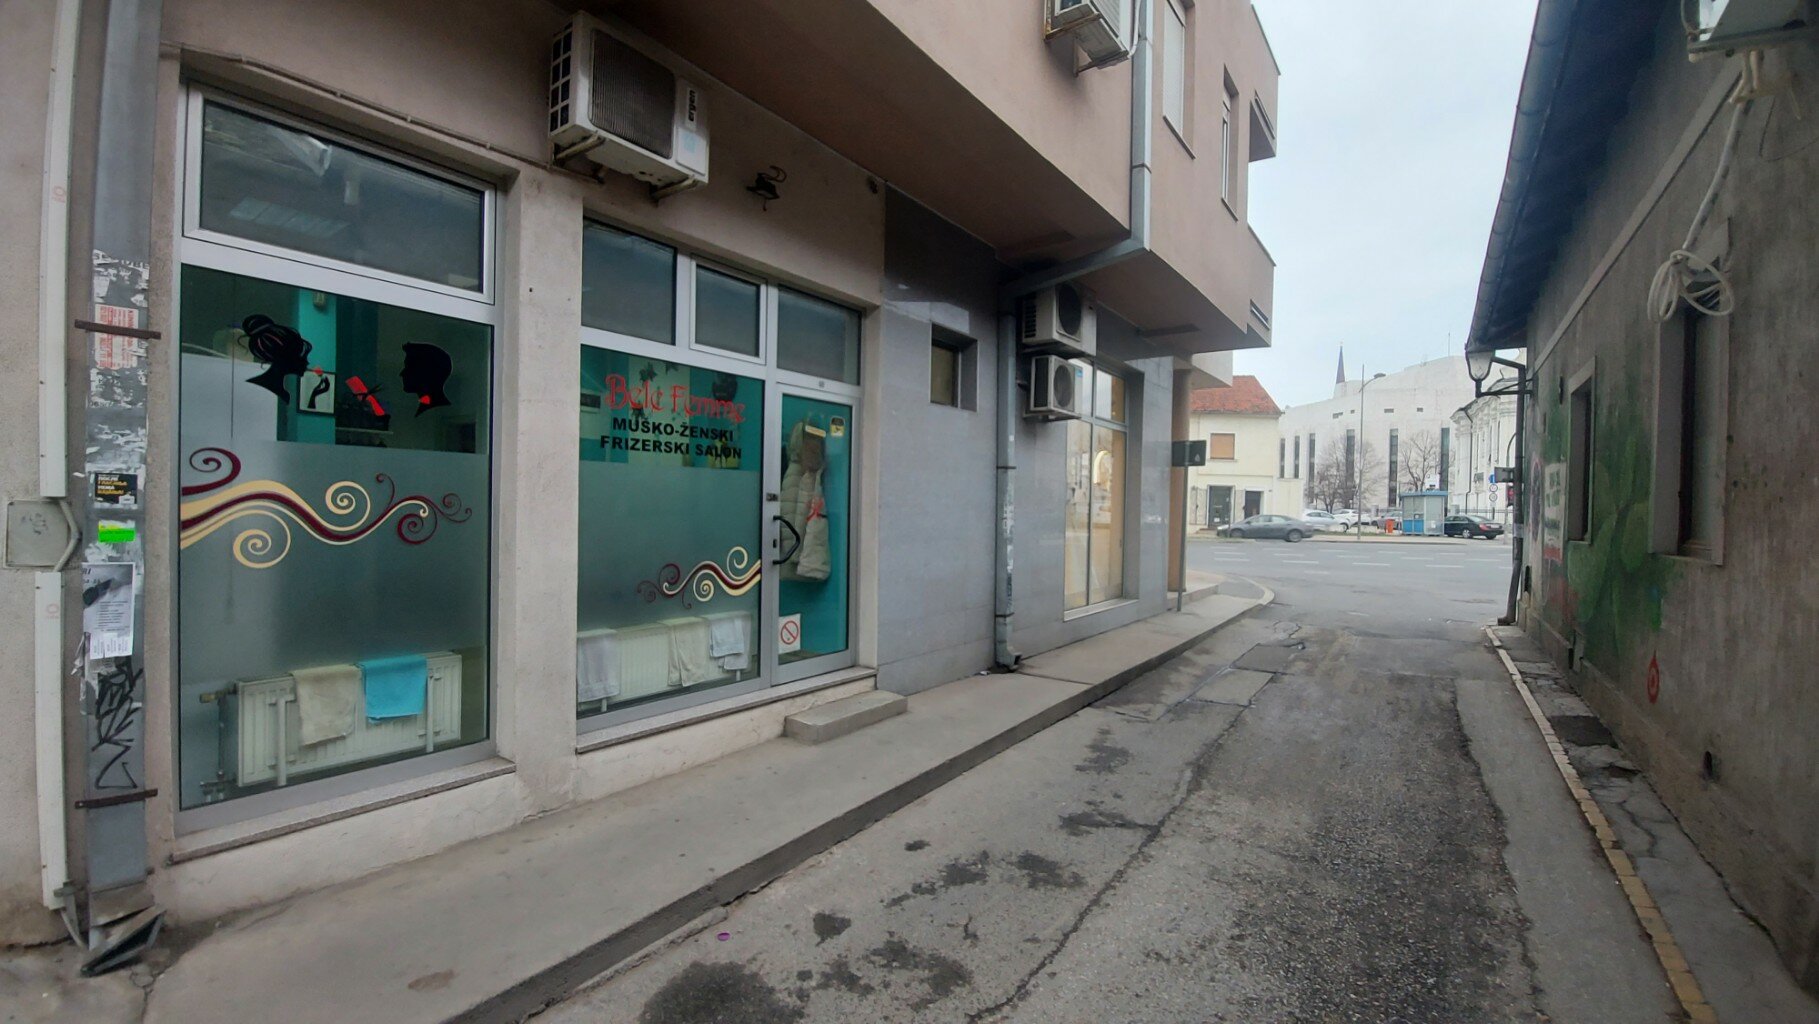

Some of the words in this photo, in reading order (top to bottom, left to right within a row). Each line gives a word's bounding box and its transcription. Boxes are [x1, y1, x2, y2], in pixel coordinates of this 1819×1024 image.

[671, 384, 746, 424] Femme
[612, 416, 734, 443] MUŠKO-ŽENSKI
[600, 434, 690, 456] FRIZERSKI
[695, 443, 743, 460] SALON
